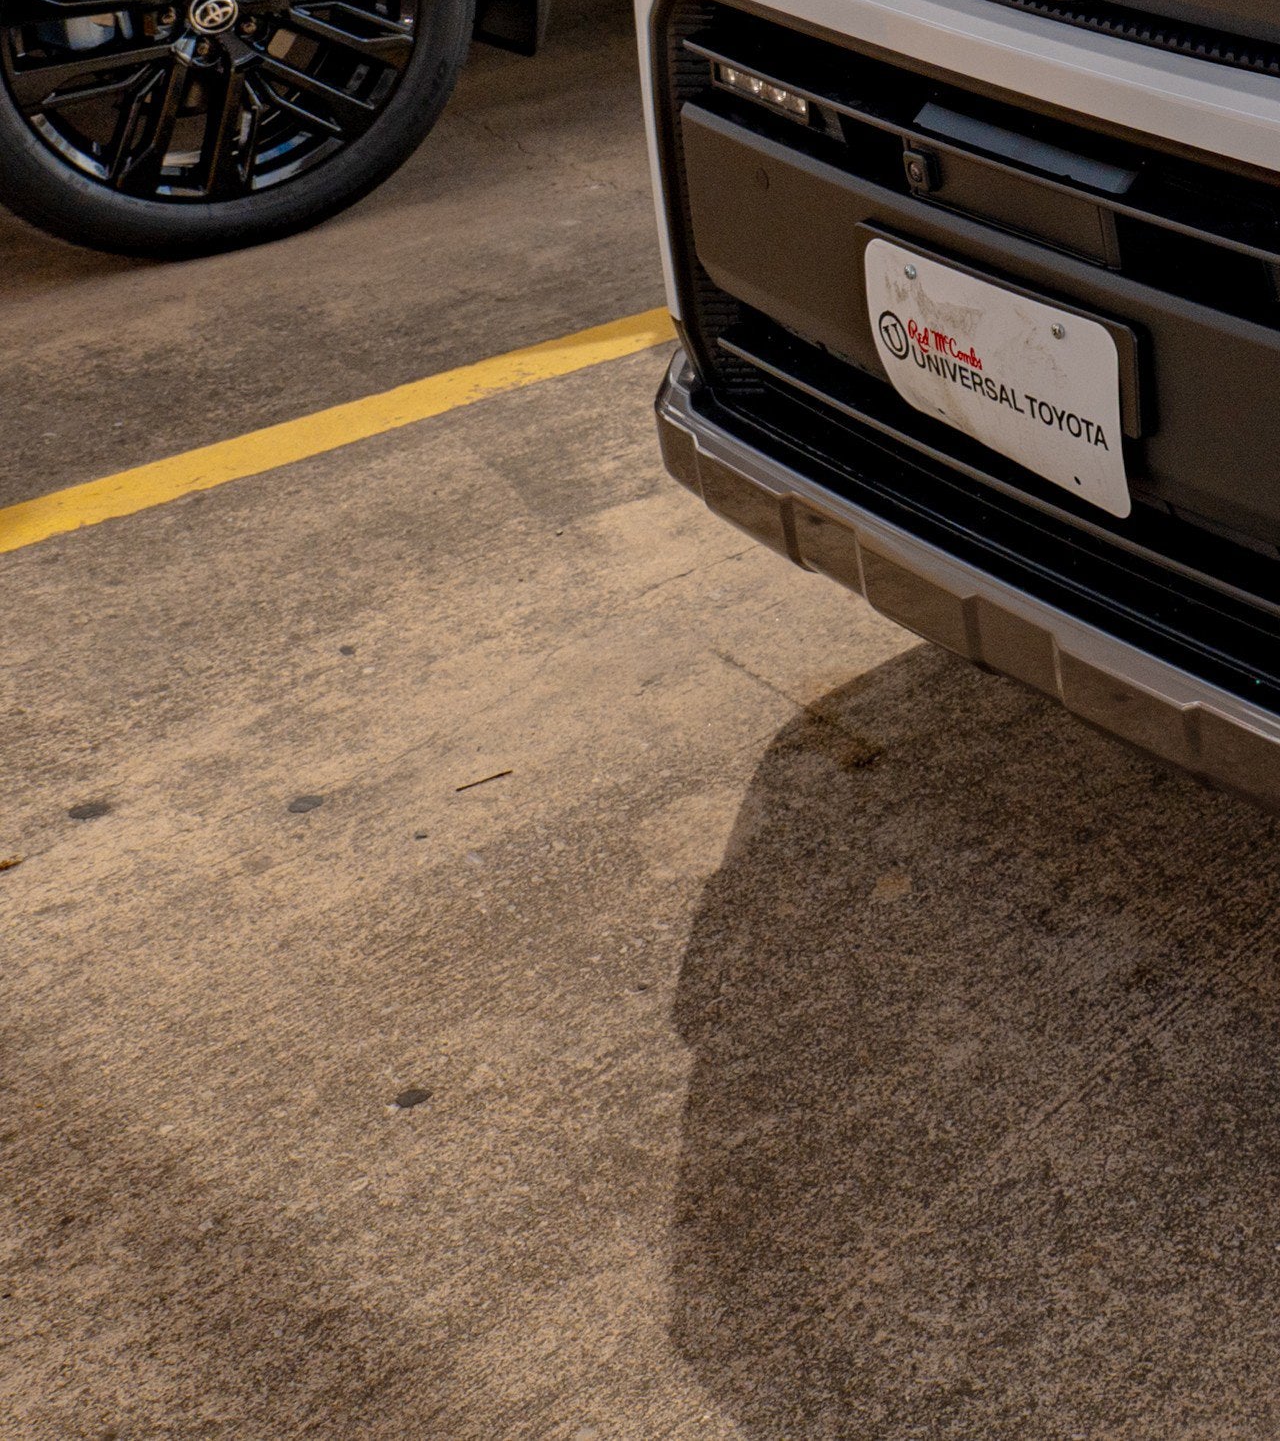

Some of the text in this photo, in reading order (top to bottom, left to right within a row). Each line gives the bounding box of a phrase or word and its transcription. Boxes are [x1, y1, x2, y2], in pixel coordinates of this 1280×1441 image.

[908, 319, 983, 370] Red McCombs
[912, 345, 1109, 451] UNIVERSAL TOYOTA
